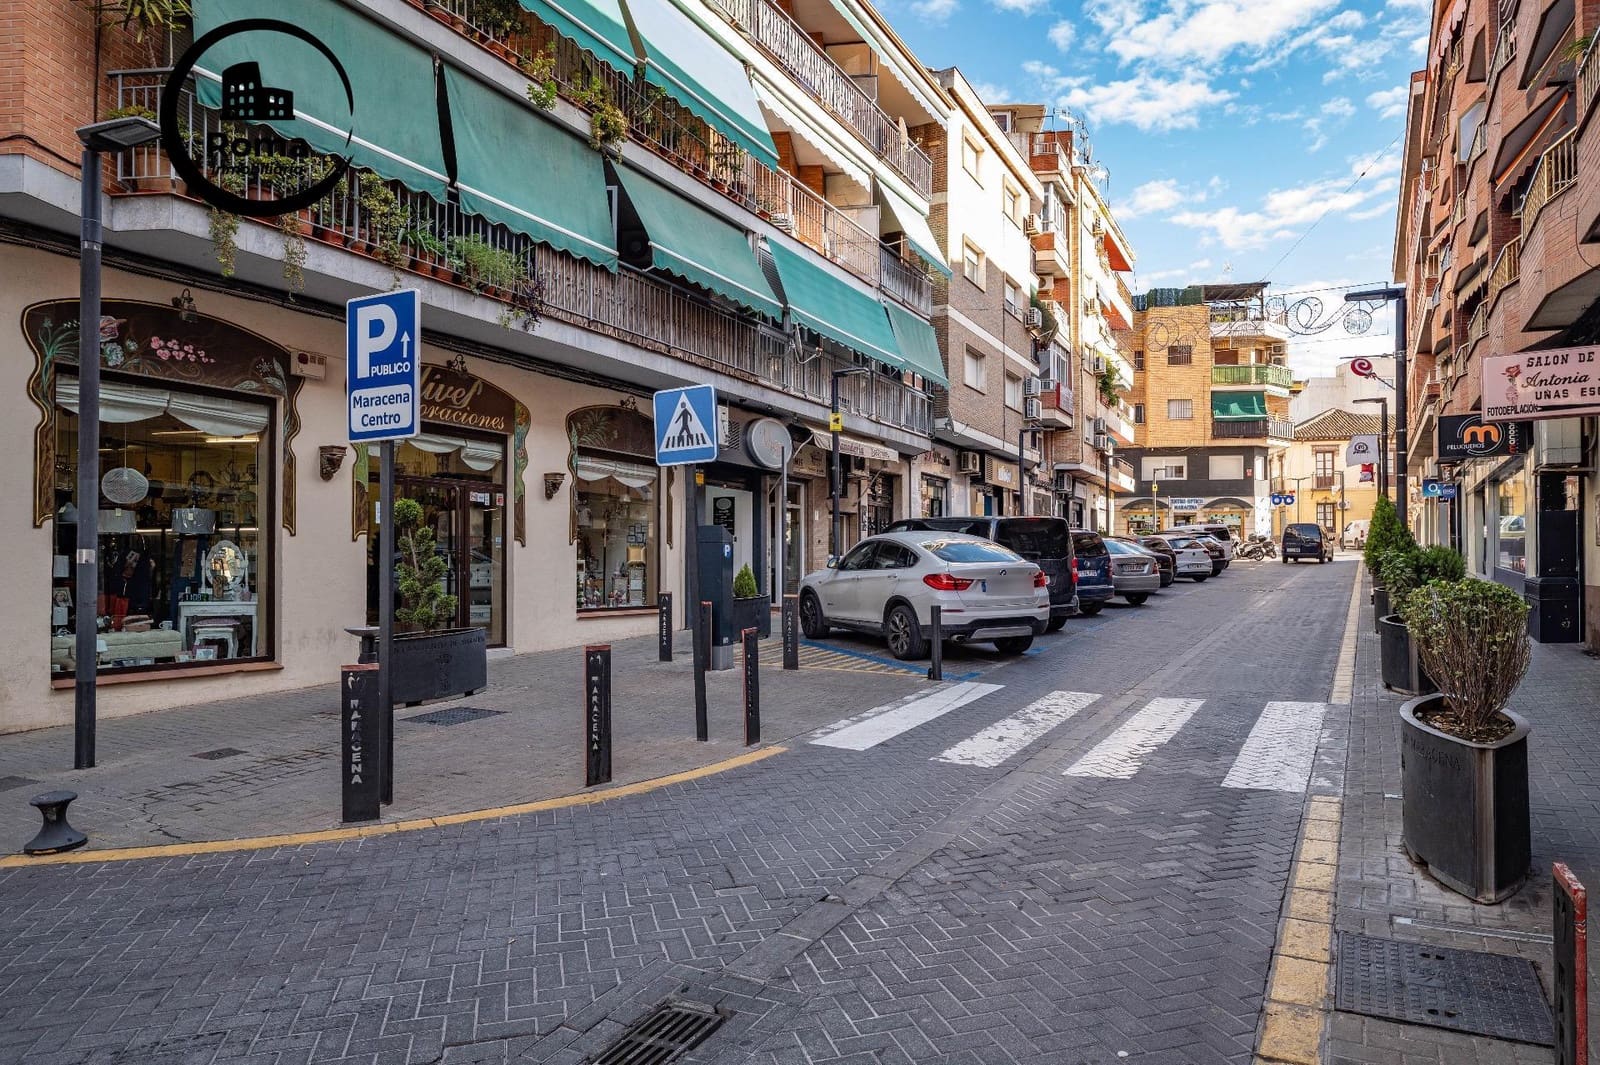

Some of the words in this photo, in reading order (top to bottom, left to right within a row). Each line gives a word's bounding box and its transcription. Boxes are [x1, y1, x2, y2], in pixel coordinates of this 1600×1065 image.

[357, 303, 397, 379] P
[1526, 354, 1569, 368] SALON
[1578, 352, 1595, 363] DE
[370, 362, 411, 377] PUBLICO
[1521, 371, 1590, 388] Antonia
[353, 392, 410, 409] Maracena
[1535, 389, 1569, 400] UÑAS
[361, 412, 401, 427] Centro
[420, 404, 505, 430] oraciones
